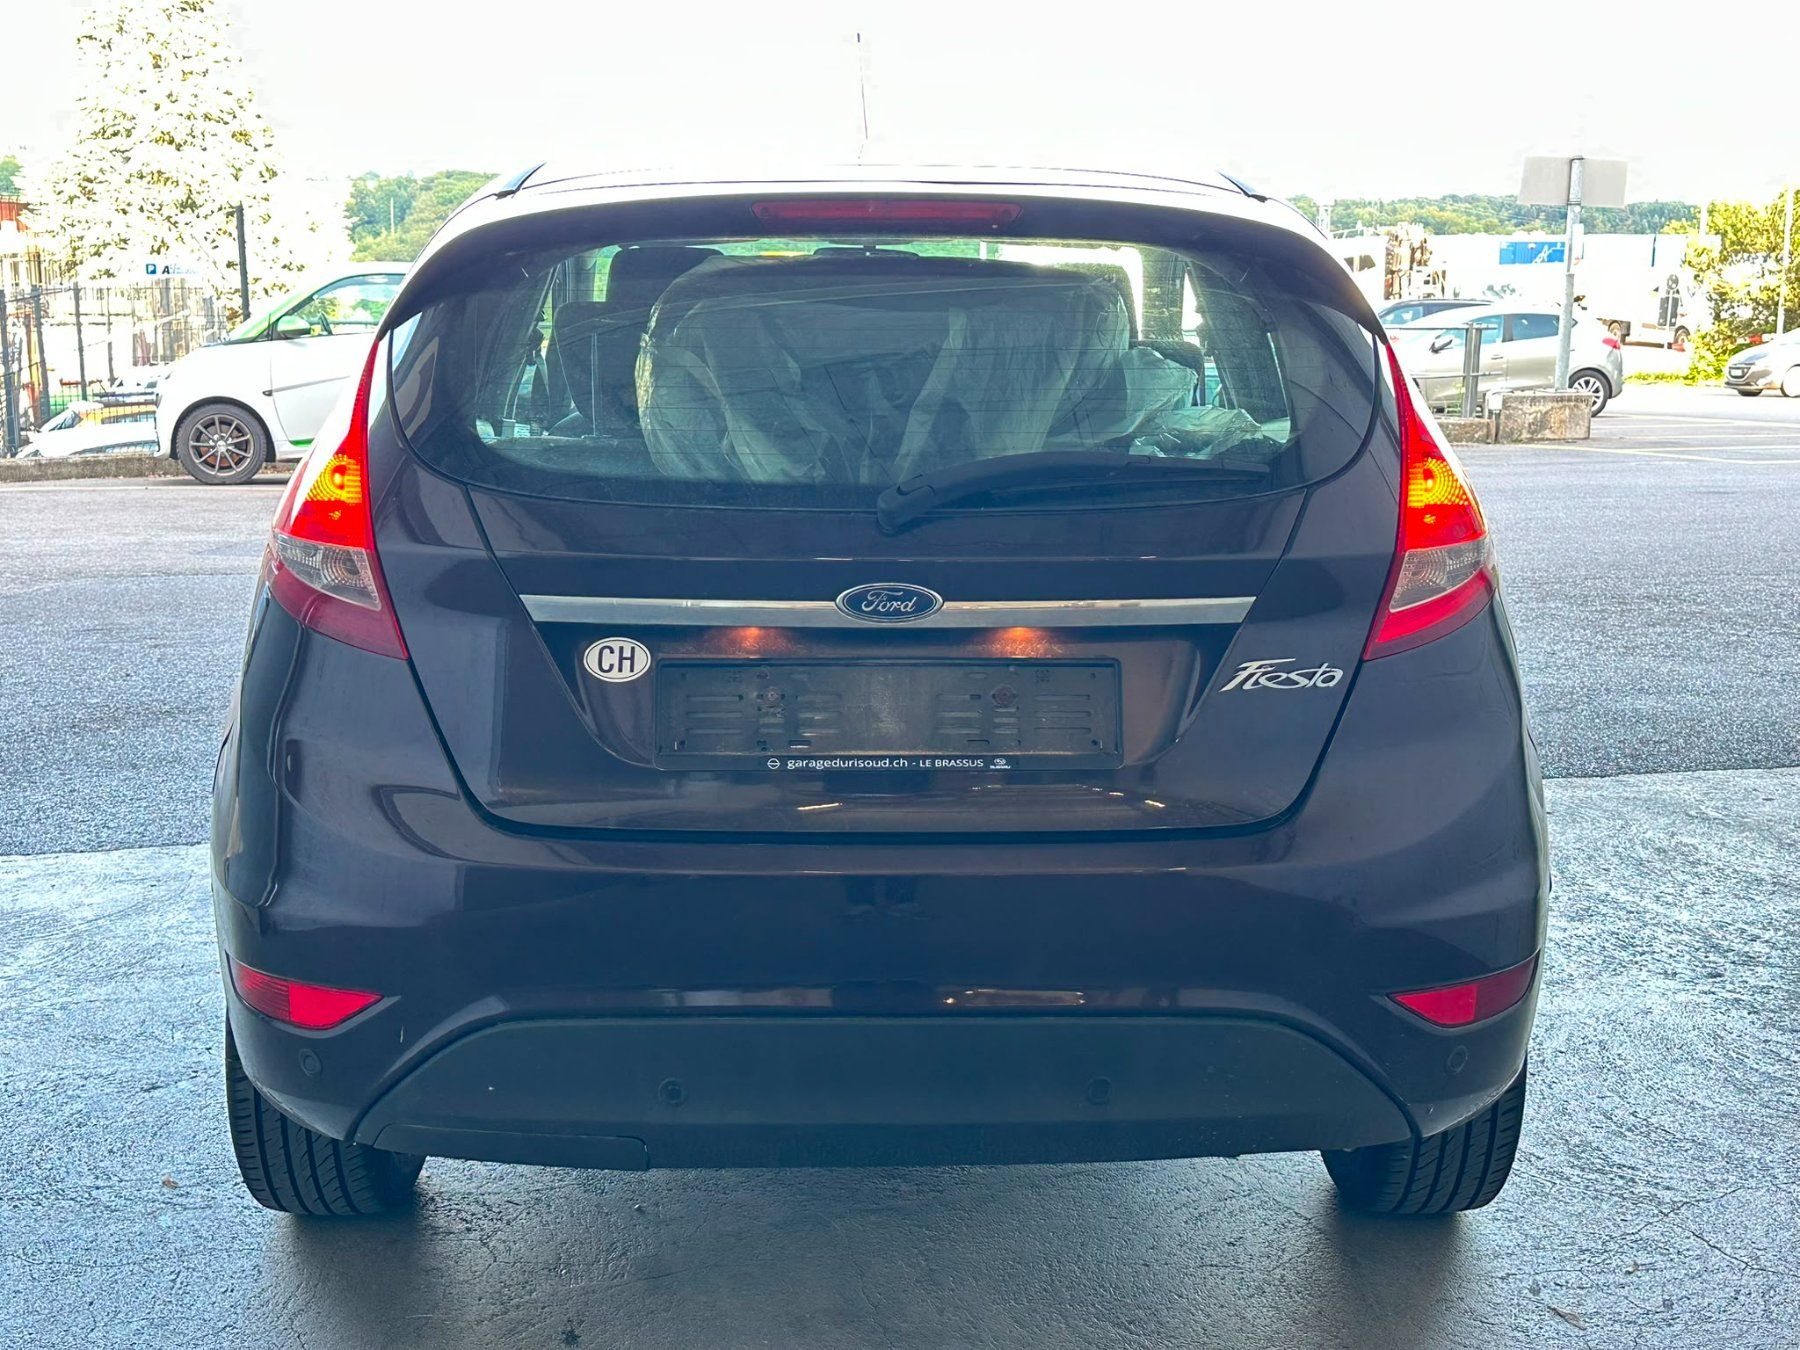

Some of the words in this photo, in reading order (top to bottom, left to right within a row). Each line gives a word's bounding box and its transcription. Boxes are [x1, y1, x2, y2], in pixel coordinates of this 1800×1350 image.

[861, 589, 917, 612] Ford
[597, 645, 636, 673] CH
[1218, 658, 1343, 692] Fiesta
[787, 758, 908, 770] garagedurisoud.ch
[919, 759, 932, 767] LE
[935, 759, 984, 767] BRASSUS
